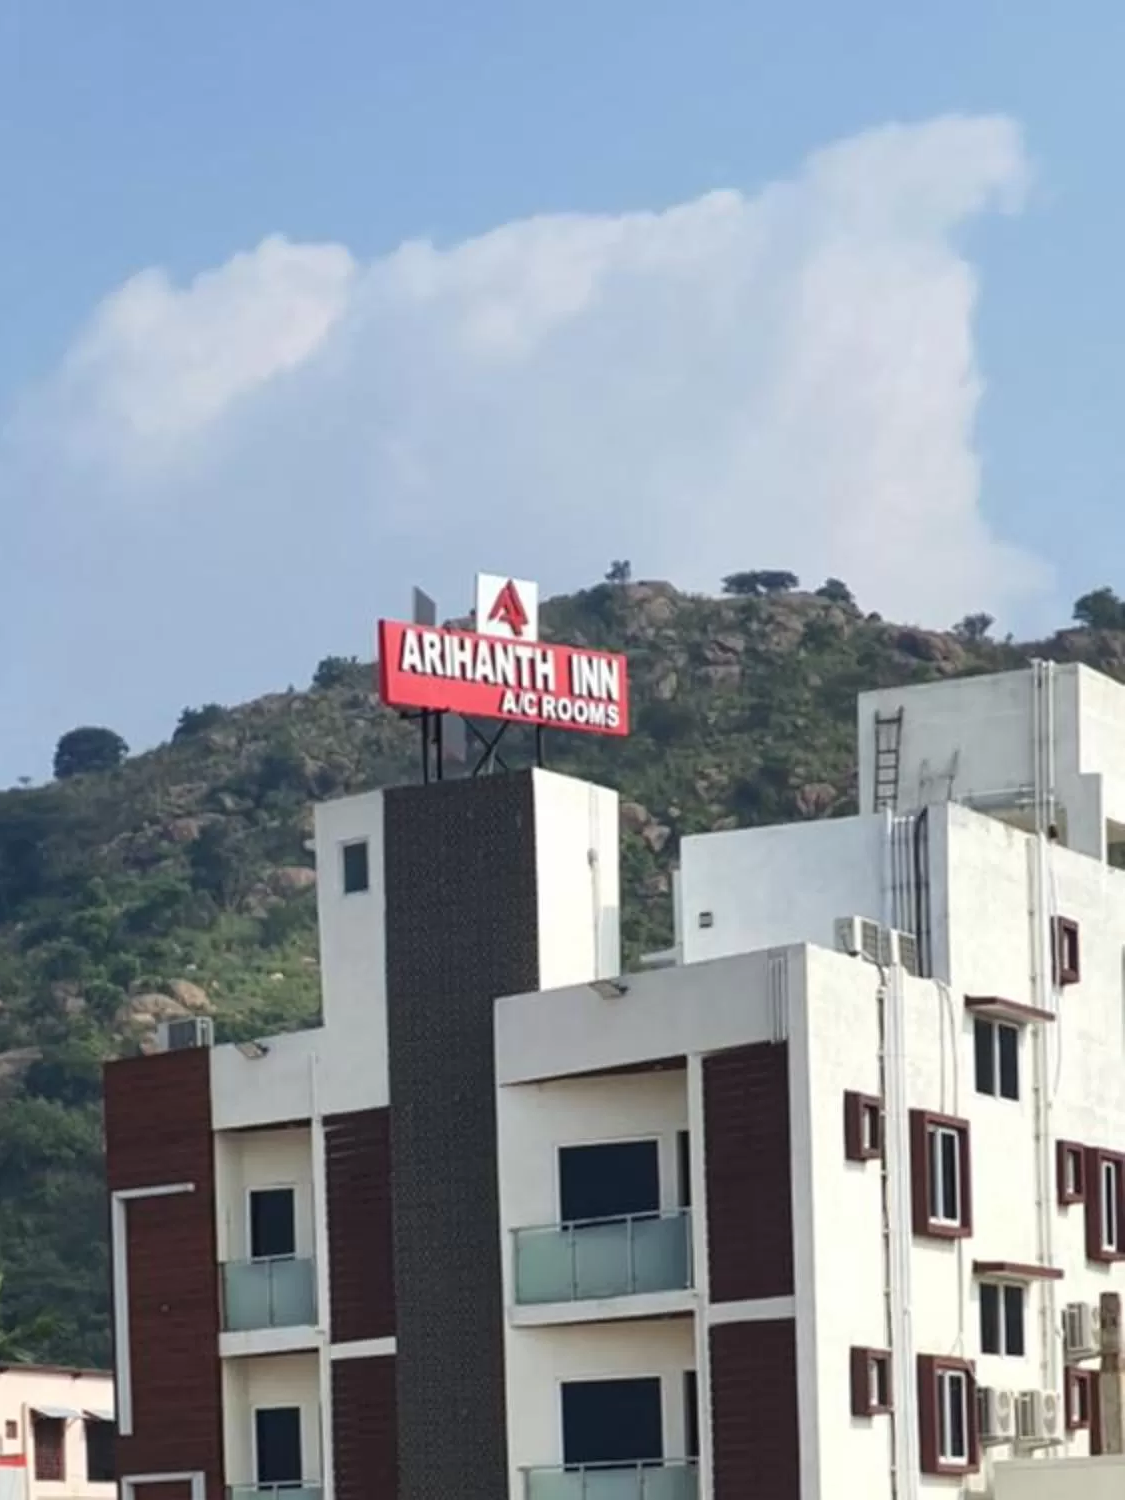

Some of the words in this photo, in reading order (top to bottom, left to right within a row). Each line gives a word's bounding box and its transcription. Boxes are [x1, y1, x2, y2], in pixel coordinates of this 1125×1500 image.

[400, 628, 555, 691] ARIHANTH
[570, 654, 618, 700] INN
[540, 696, 619, 728] ROOMS
